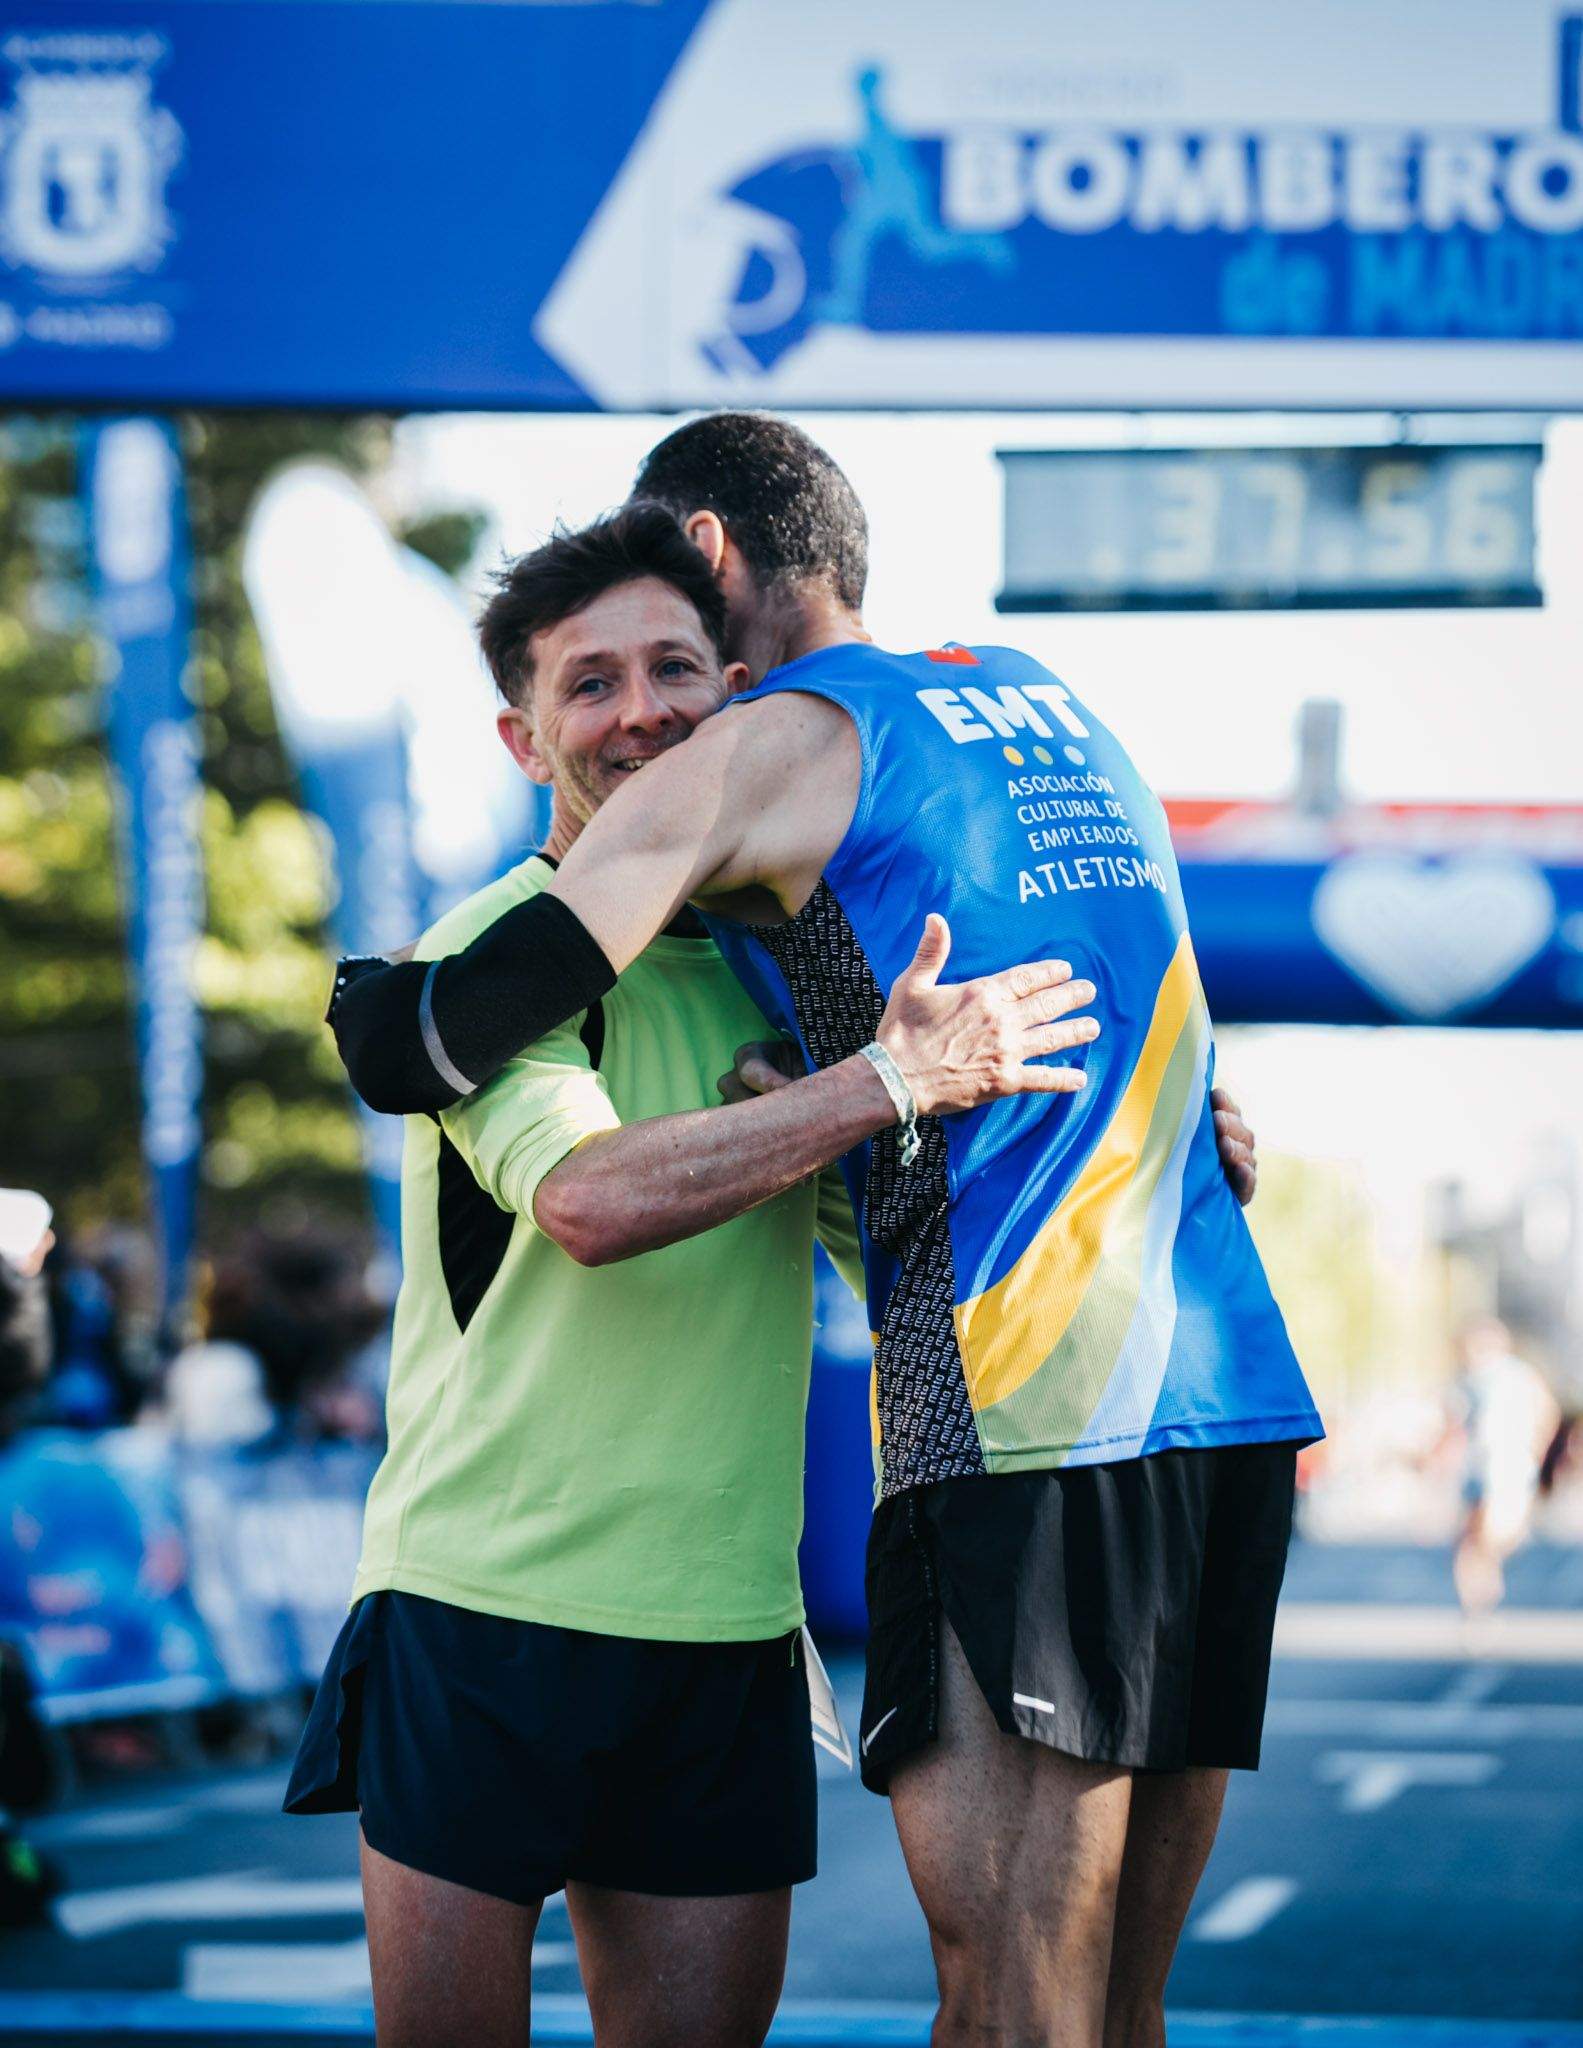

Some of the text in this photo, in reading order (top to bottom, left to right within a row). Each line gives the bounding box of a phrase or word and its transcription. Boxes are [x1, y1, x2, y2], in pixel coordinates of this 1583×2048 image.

[915, 685, 1090, 744] EMT
[1007, 771, 1115, 799] ASOCIACIÓN
[1017, 800, 1128, 825] CULTURAL DE
[1028, 826, 1139, 852] EMPLEADOS
[1018, 856, 1167, 903] ATLETISMO
[828, 924, 838, 955] mitto
[906, 1242, 921, 1270] mitto
[927, 1245, 940, 1274] mitto
[897, 1275, 911, 1303] mitto
[912, 1264, 925, 1293] mitto
[927, 1268, 942, 1295] mitto
[931, 1282, 946, 1310] mitto
[887, 1307, 901, 1335] mitto
[901, 1297, 916, 1325] mitto
[914, 1300, 929, 1327] mitto
[932, 1303, 946, 1331] mitto
[918, 1315, 932, 1342] mitto
[935, 1318, 951, 1346] mitto
[920, 1336, 934, 1364] mitto
